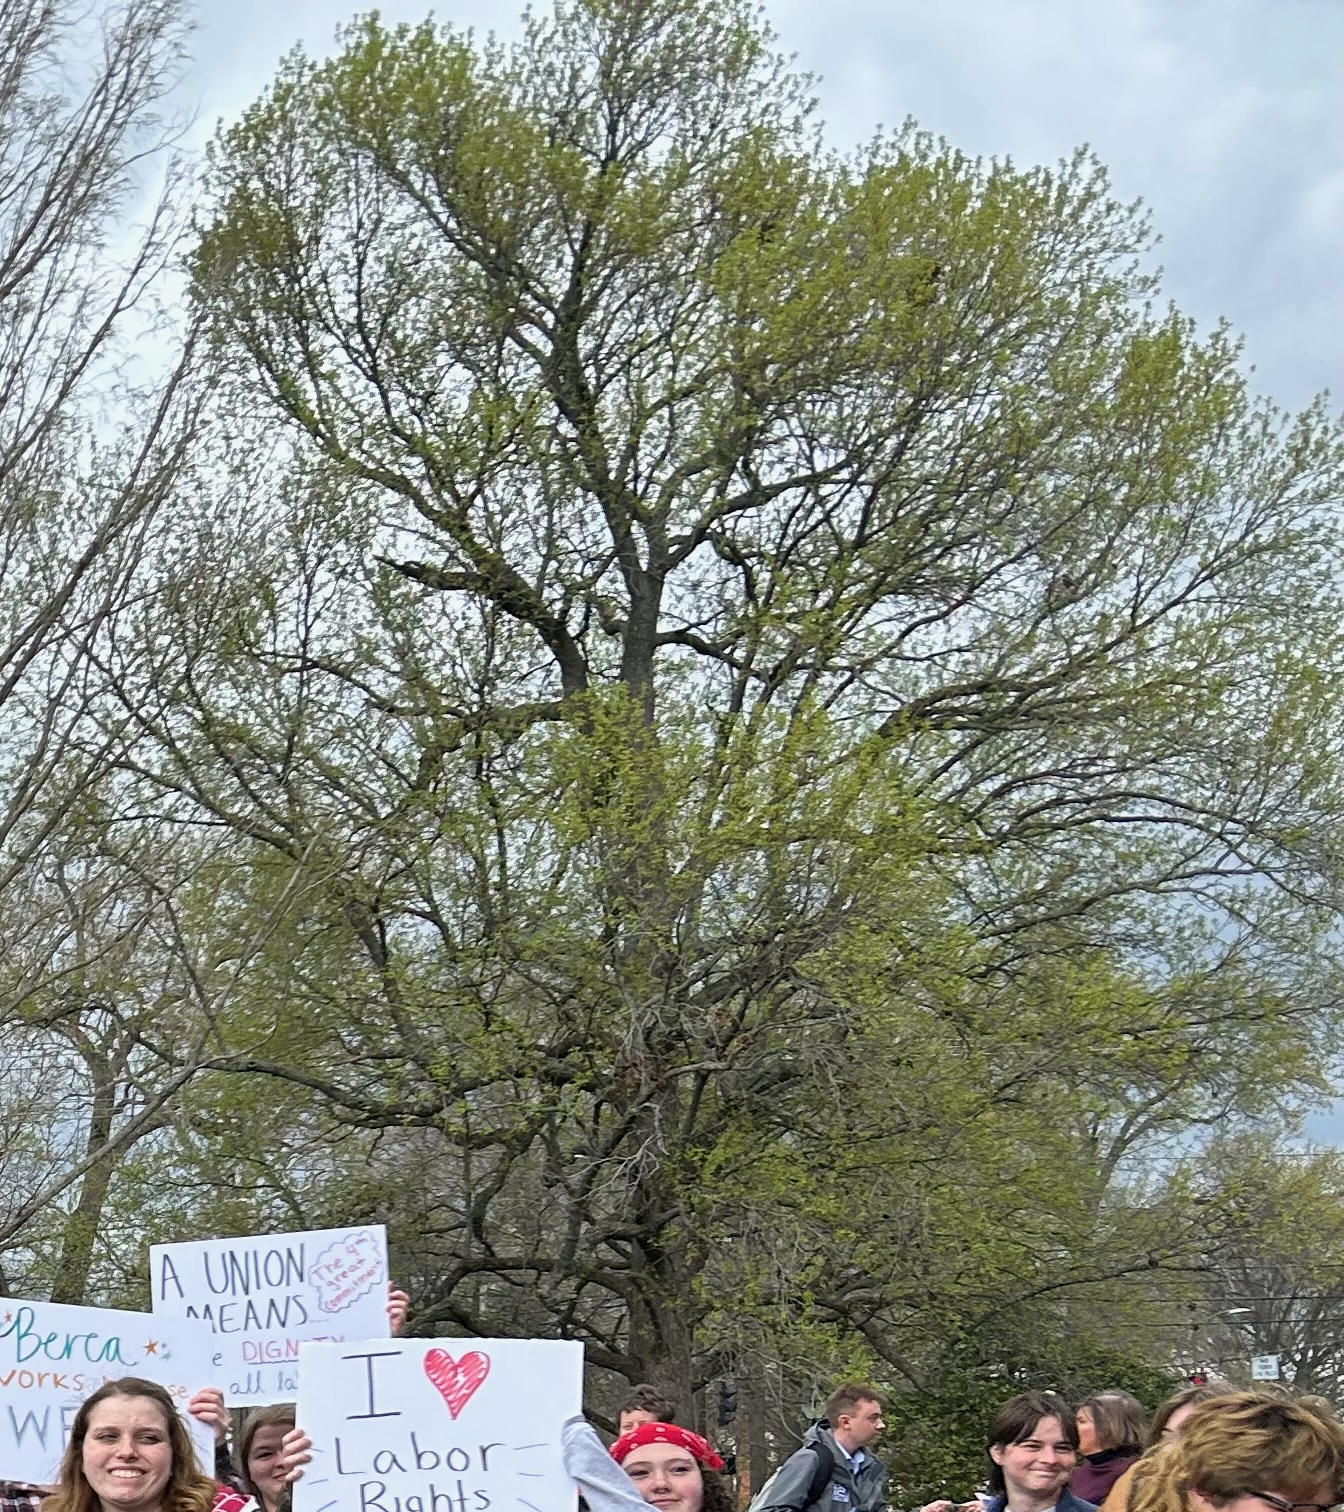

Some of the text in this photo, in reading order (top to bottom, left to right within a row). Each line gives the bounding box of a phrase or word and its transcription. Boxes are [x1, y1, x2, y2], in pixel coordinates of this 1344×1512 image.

[160, 1253, 185, 1302] A
[202, 1243, 306, 1297] UNION
[326, 1259, 368, 1291] great
[341, 1351, 402, 1420] I
[334, 1431, 507, 1476] Labor
